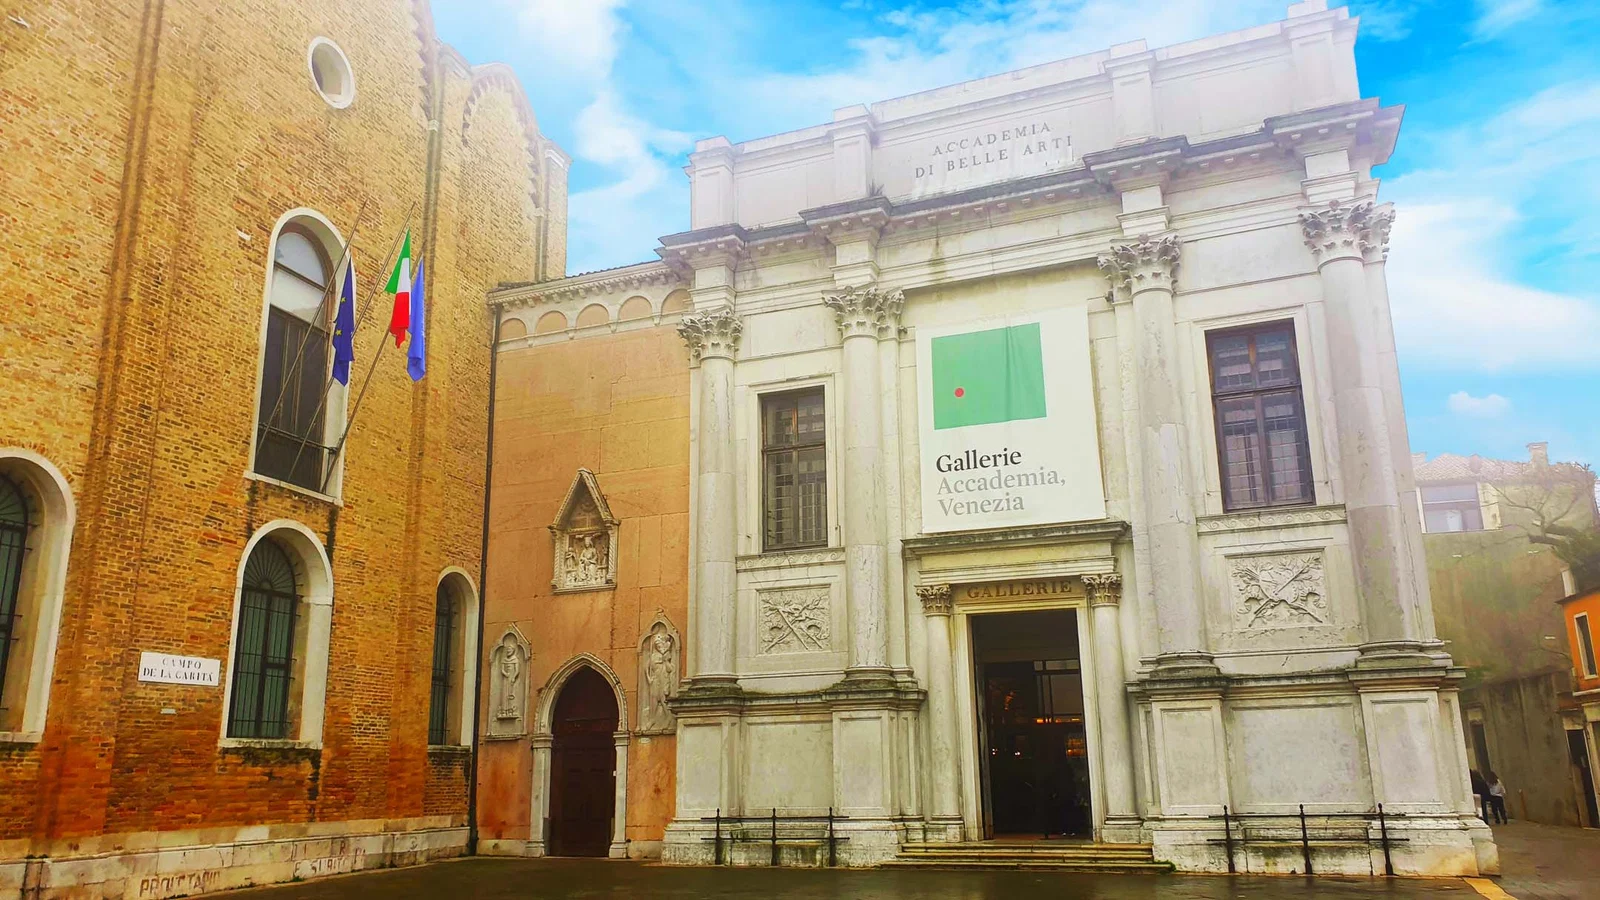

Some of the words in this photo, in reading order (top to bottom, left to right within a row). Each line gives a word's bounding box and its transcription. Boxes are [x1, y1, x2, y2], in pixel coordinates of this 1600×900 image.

[932, 122, 1051, 156] ACCADEMIA
[915, 165, 934, 178] DI
[947, 149, 1008, 171] BELLE
[1022, 135, 1072, 155] ARTI
[936, 447, 1022, 473] Gallerie
[937, 466, 1066, 495] Accademia,
[938, 492, 1025, 517] Venezia
[966, 580, 1072, 598] GALLERIE
[143, 667, 157, 677] DE
[160, 669, 171, 679] LA
[162, 658, 202, 669] CAMPO
